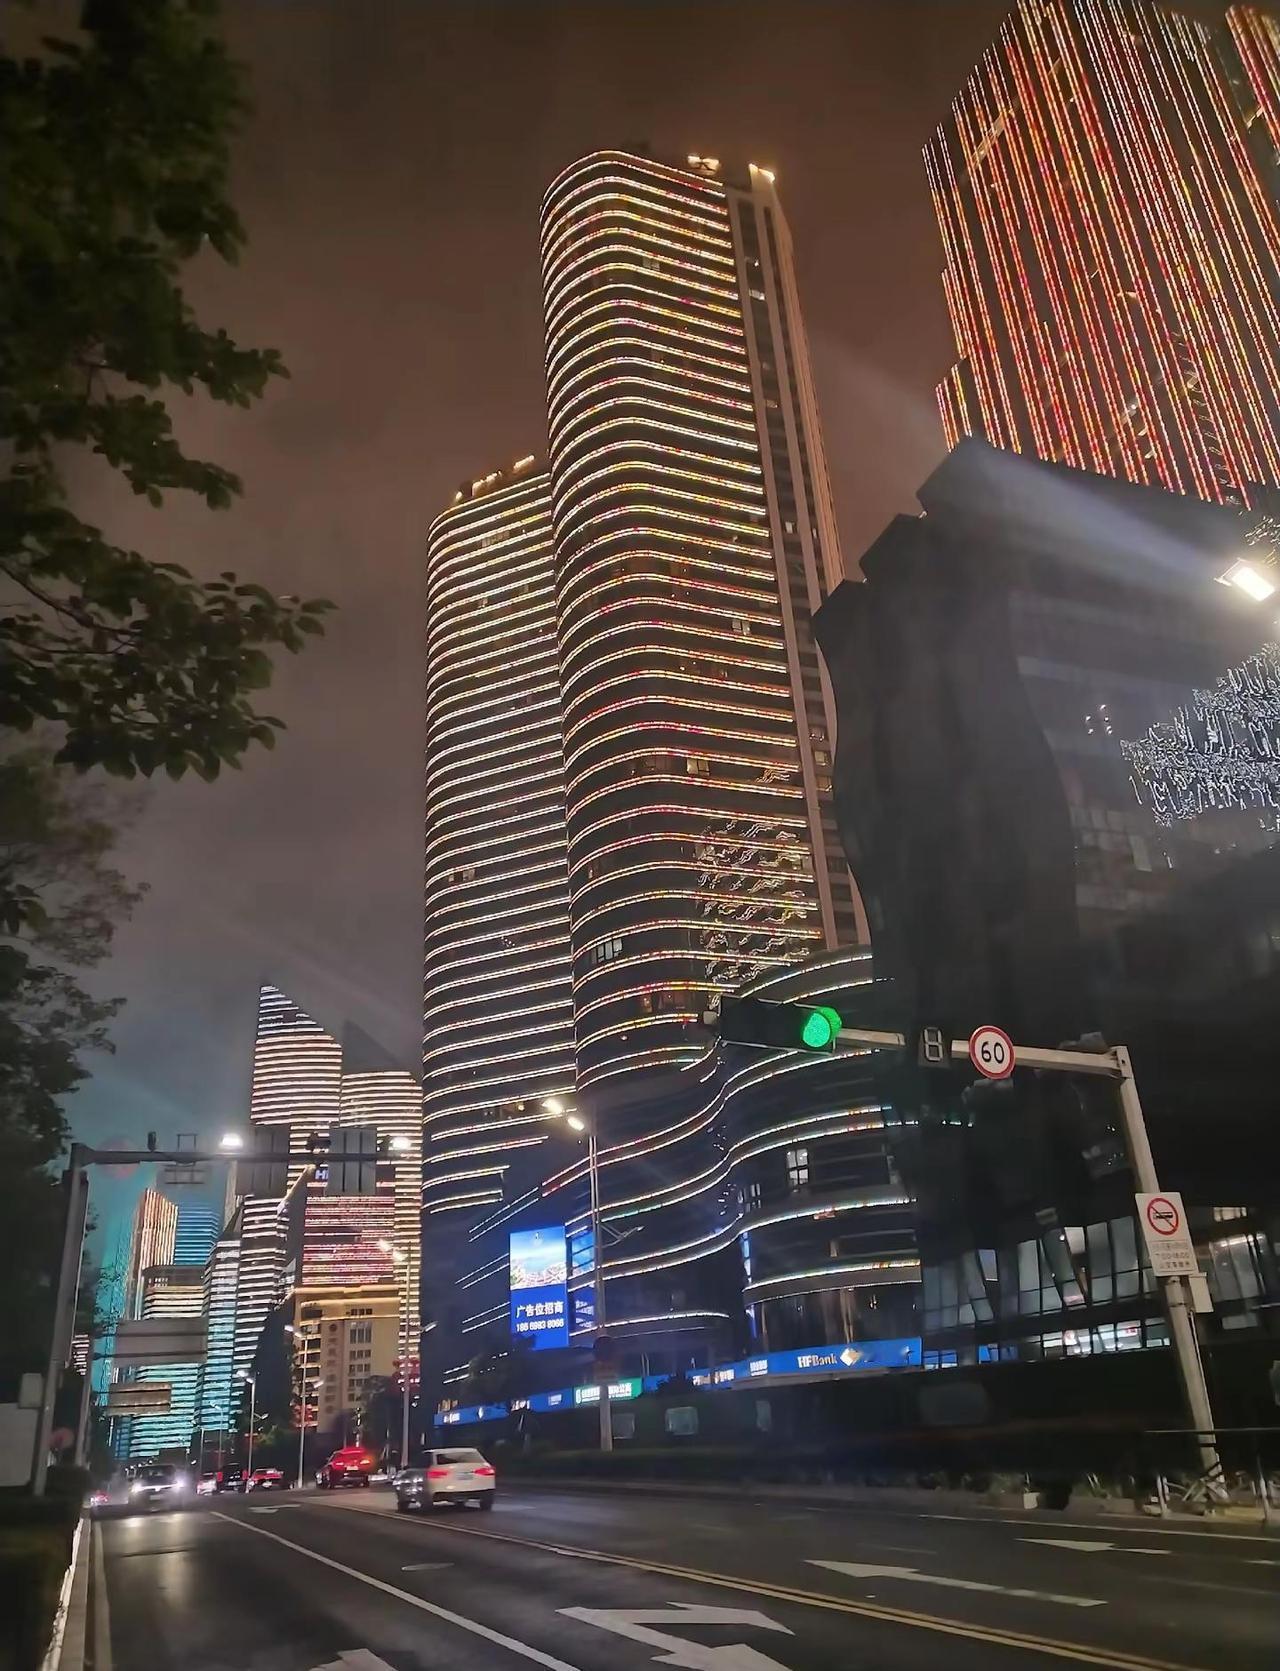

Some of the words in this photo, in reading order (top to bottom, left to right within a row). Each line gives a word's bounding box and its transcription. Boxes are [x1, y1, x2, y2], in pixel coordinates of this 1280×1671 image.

[981, 1041, 1005, 1064] 60
[516, 1300, 564, 1318] 广告位招商
